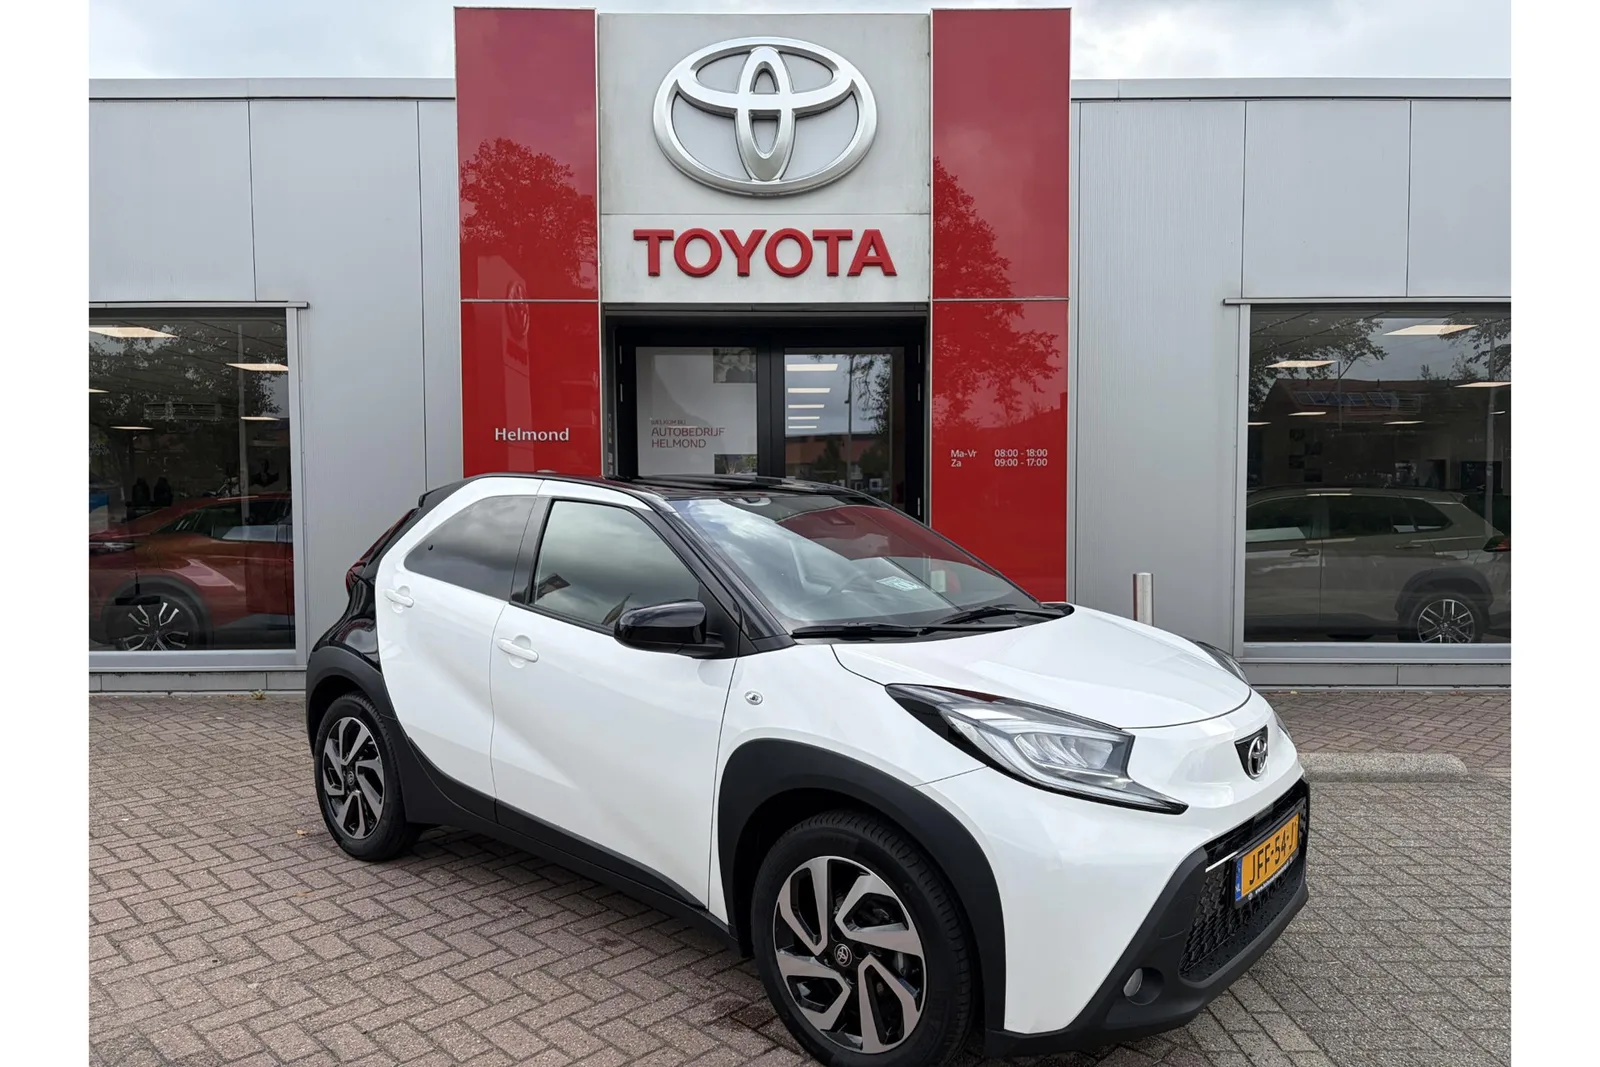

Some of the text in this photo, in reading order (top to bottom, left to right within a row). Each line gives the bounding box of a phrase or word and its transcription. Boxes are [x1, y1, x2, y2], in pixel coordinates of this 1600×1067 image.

[633, 228, 897, 278] TOYOTA
[495, 427, 569, 441] Helmond
[651, 427, 725, 437] AUTOBEDRIJF
[651, 439, 707, 448] HELMOND
[950, 449, 977, 458] Ma-Vr
[994, 449, 1019, 458] 08:00
[1026, 449, 1048, 458] 18:00
[951, 459, 962, 467] Za
[994, 458, 1019, 467] 09:00
[1026, 458, 1048, 467] 17:00
